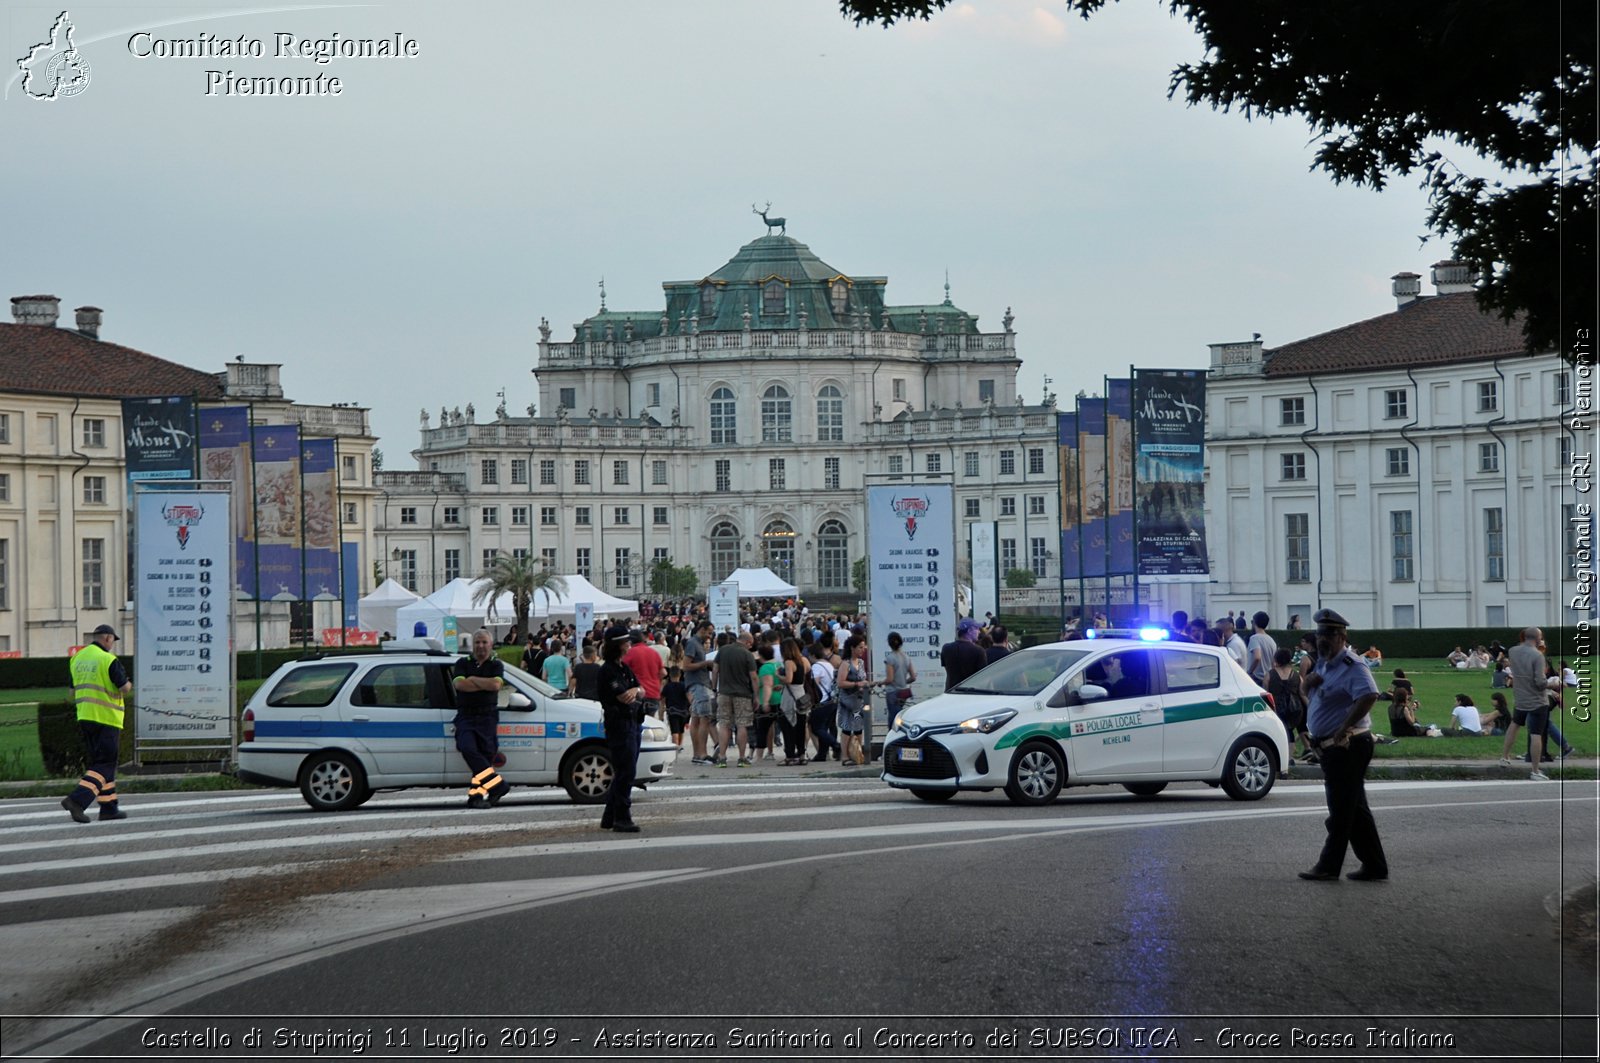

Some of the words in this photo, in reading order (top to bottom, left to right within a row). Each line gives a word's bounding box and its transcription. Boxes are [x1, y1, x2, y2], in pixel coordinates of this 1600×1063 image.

[1140, 393, 1202, 423] Monet
[127, 419, 191, 449] Monet
[896, 500, 926, 511] STUPINIGI
[514, 725, 543, 734] CIVILE
[1086, 719, 1114, 732] POLIZIA
[1115, 714, 1142, 728] LOCALE
[1102, 734, 1132, 745] NICHELINO
